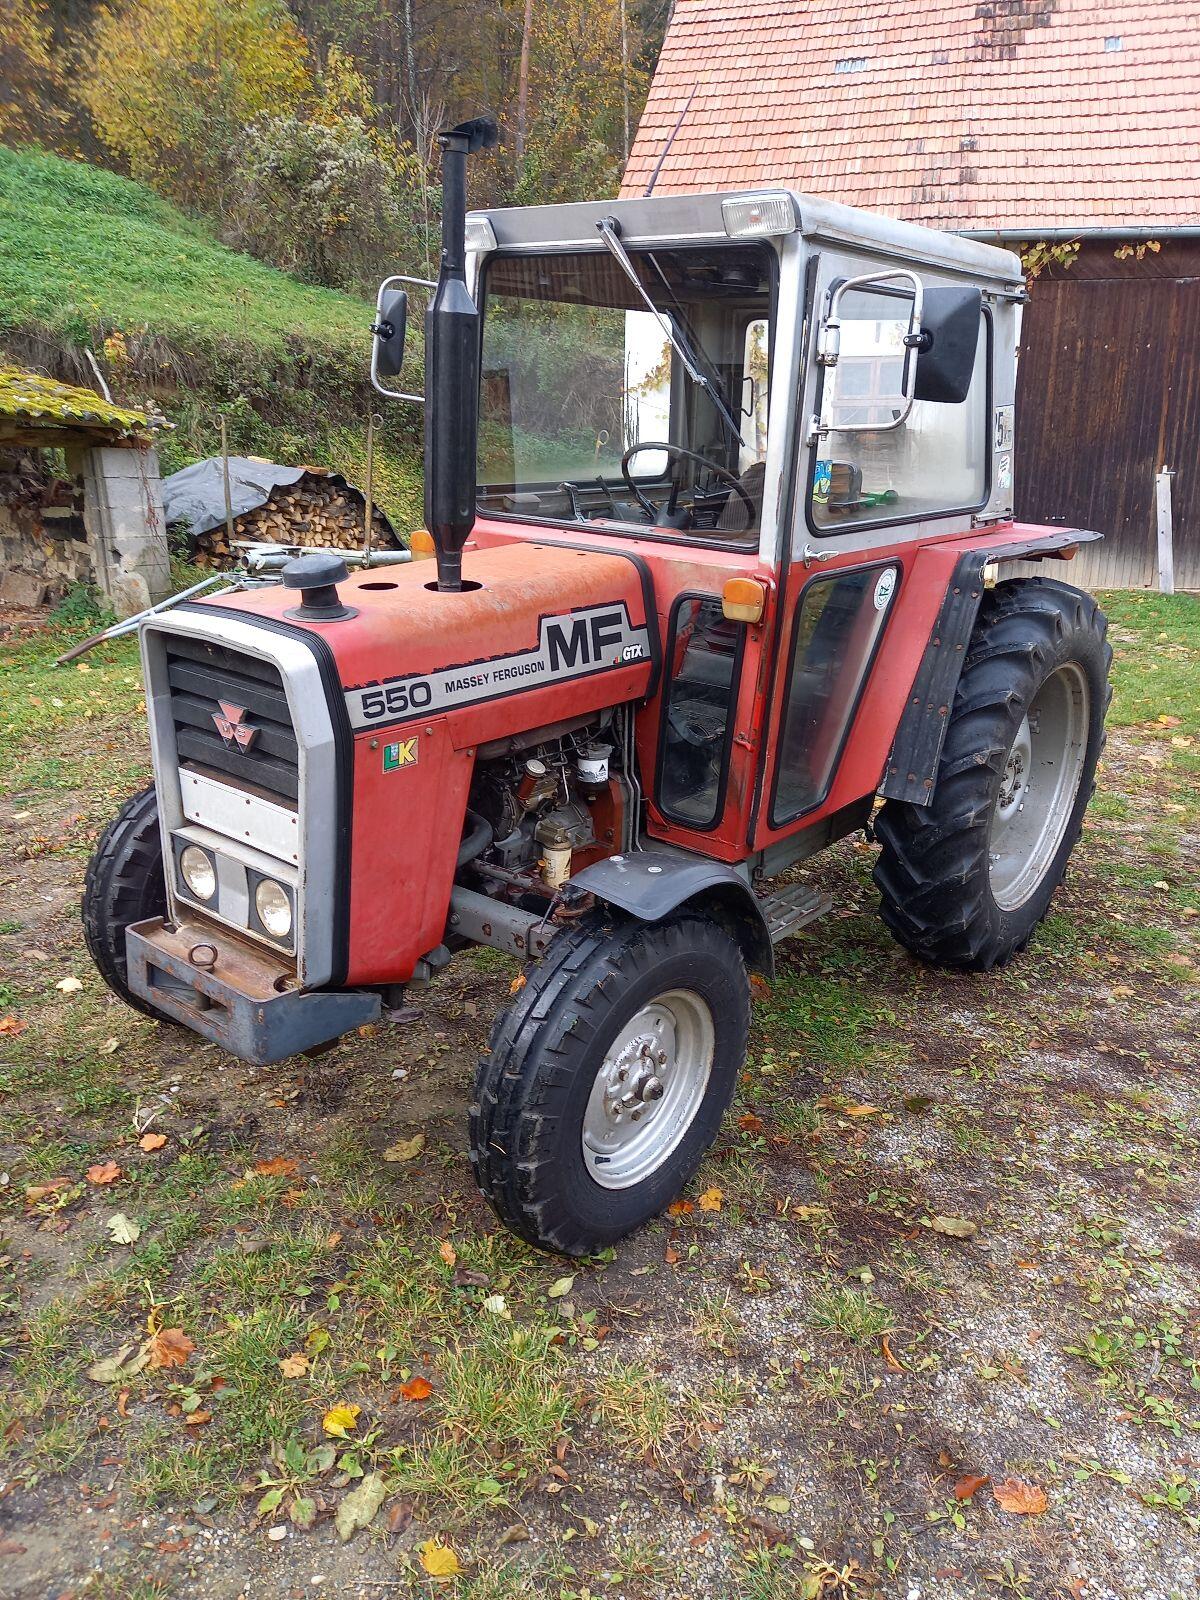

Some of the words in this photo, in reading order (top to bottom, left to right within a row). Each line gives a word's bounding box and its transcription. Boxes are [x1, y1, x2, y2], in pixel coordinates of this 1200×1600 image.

[546, 612, 622, 672] MF
[622, 643, 643, 661] GTX
[445, 673, 489, 693] MASSEY
[492, 660, 545, 682] FERGUSON
[361, 682, 432, 719] 550
[384, 738, 417, 770] LK
